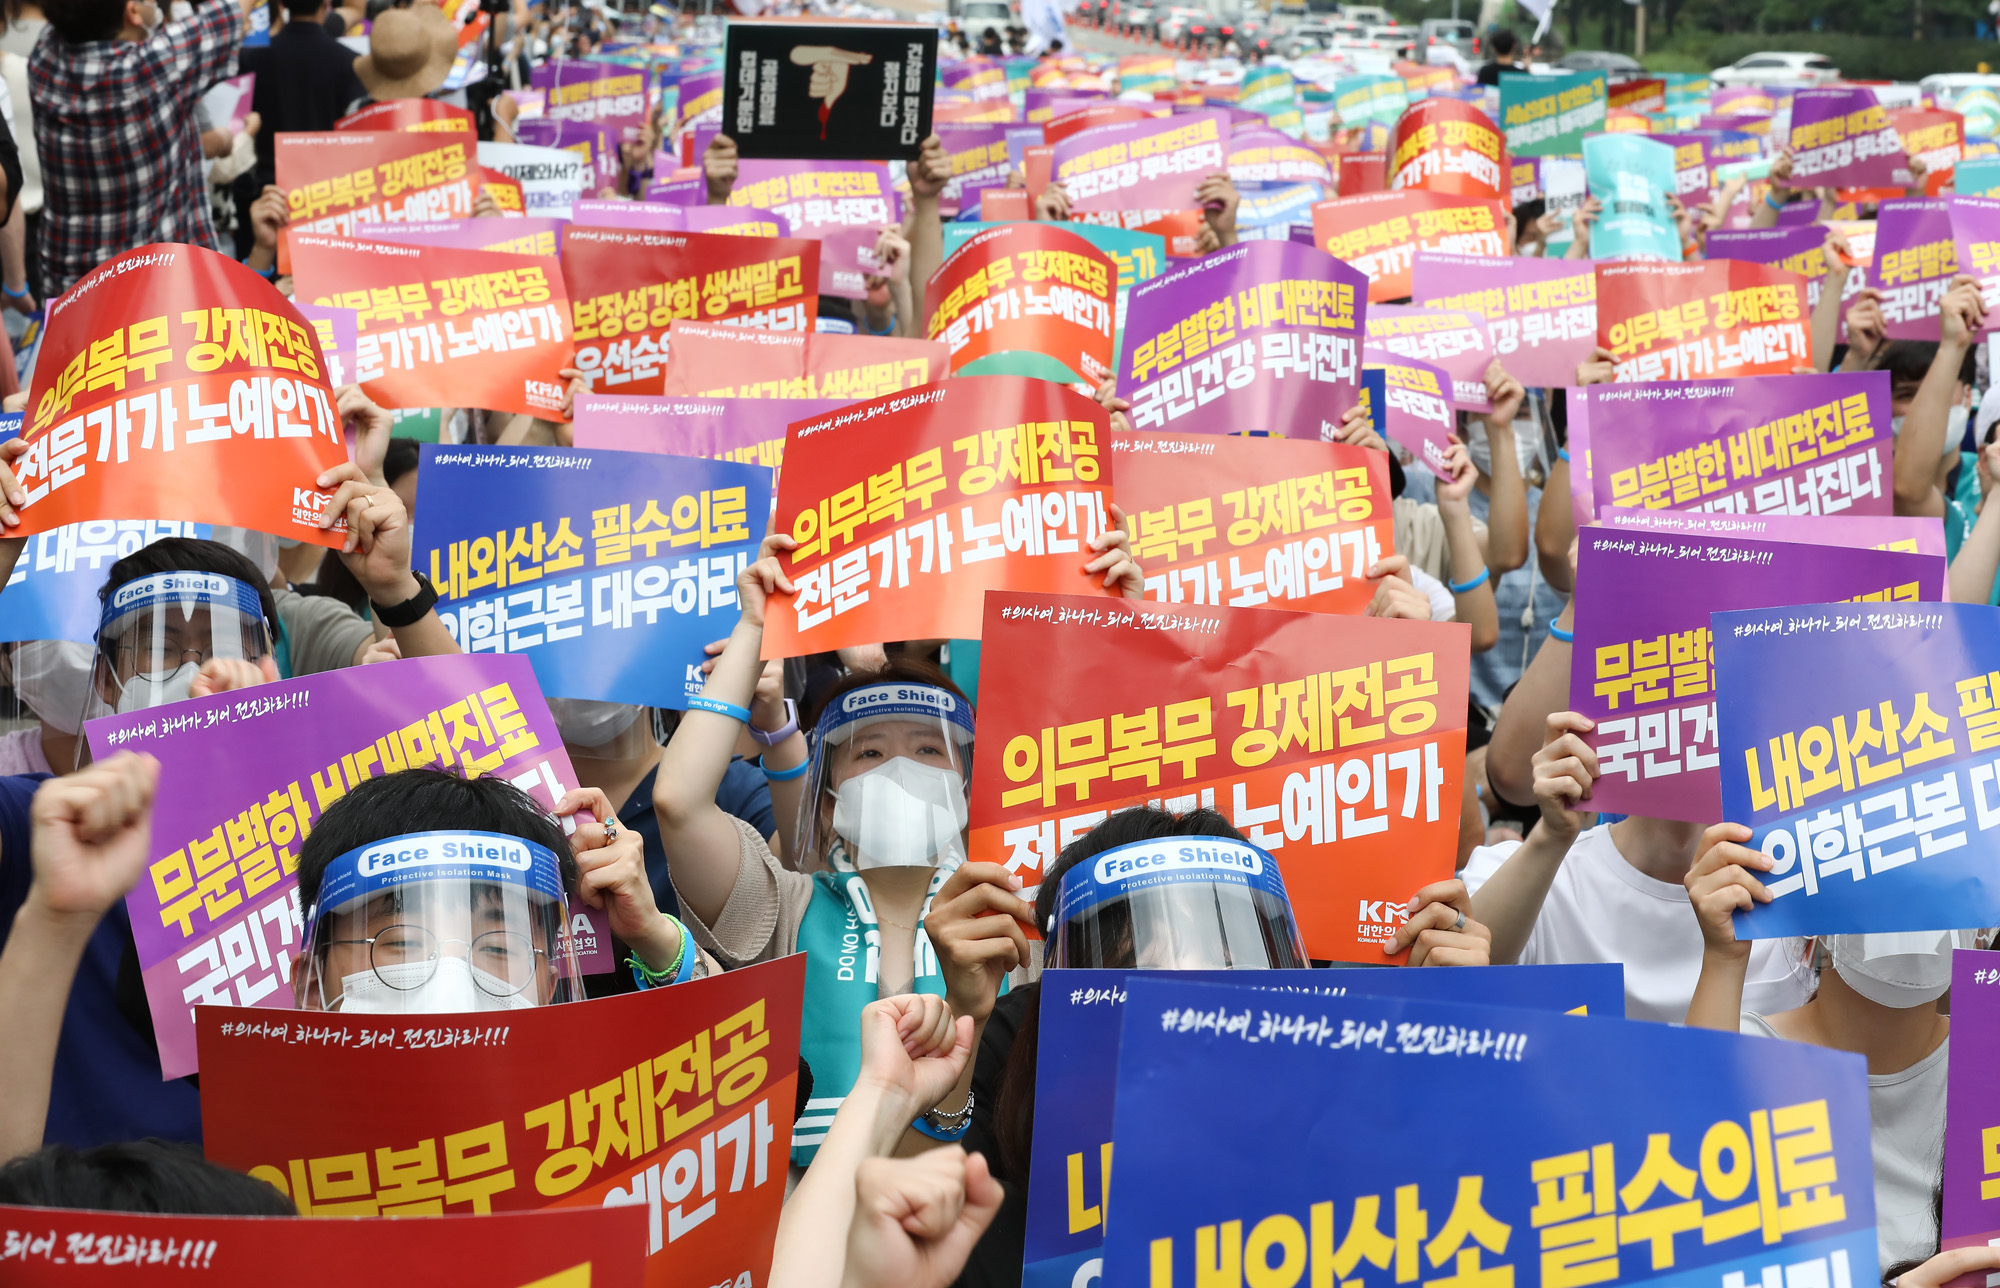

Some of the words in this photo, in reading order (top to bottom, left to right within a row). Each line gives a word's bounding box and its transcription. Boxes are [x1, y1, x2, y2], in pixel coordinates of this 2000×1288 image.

[288, 167, 377, 220] 의무복무
[378, 142, 466, 198] 강제전공
[1412, 206, 1496, 238] 강제전공
[431, 266, 551, 317] 강제전공
[574, 277, 700, 341] 보장성강화
[701, 255, 803, 317] 생색말고
[1018, 250, 1109, 298] 강제전공
[1024, 284, 1112, 338] 노예인가
[356, 322, 444, 384] 문가가
[444, 304, 564, 359] 노예인가
[1131, 295, 1236, 384] 무분별한
[1238, 278, 1355, 330] 비대면진료
[1609, 298, 1708, 356] 의무복무
[1710, 284, 1800, 330] 강제전공
[1717, 322, 1807, 370] 노예인가
[25, 315, 172, 441] 의무복무
[181, 306, 320, 380] 강제전공
[1132, 338, 1256, 429] 국민건강
[1261, 332, 1357, 386] 무너진다
[15, 387, 178, 511] 전문가가
[186, 376, 340, 445] 노예인가
[797, 389, 946, 438] #의사여_하나가_되어_전진하라!!!
[1610, 439, 1727, 509] 무분별한
[1728, 391, 1875, 481] 비대면진료
[435, 453, 592, 470] #의사여_하나가_되어_전진하라!!!
[791, 446, 947, 565] 의무복무
[953, 420, 1100, 495] 강제전공
[430, 516, 584, 601] 내외산소
[591, 486, 749, 566] 필수의료
[1221, 466, 1373, 547] 강제전공
[1614, 515, 1766, 532] #의사여_하나가_되어_전진하라!!!
[792, 512, 953, 632] 전문가가
[961, 490, 1108, 566] 노예인가
[1228, 525, 1382, 608] 노예인가
[1593, 539, 1774, 565] #의사여_하나가_되어_전진하라!!!
[118, 584, 154, 603] Face
[162, 579, 220, 590] Shield
[1001, 605, 1220, 635] #의사여_하나가_되어_전진하라!!!
[1734, 613, 1943, 638] #의사여_하나가_되어_전진하라!!!
[848, 692, 889, 708] Face
[897, 689, 949, 707] Shield
[1594, 627, 1714, 711] 무분별
[107, 690, 310, 745] #의사여_하나가_되어_전진하라!!!
[857, 707, 892, 717] Protective
[1001, 696, 1217, 809] 의무복무
[1226, 652, 1439, 768] 강제전공
[1597, 701, 1719, 782] 국민건
[1745, 692, 1956, 812] 내외산소
[1233, 742, 1444, 851] 노예인가
[149, 780, 312, 938] 무분별한
[368, 847, 429, 870] Face
[442, 842, 521, 865] Shield
[1104, 853, 1166, 878] Face
[1178, 847, 1254, 869] Shield
[1760, 771, 1969, 900] 의학근본
[381, 871, 434, 885] Protective
[437, 868, 484, 876] Isolation
[487, 870, 512, 880] Mask
[1120, 873, 1173, 891] Protective
[1176, 872, 1221, 881] Isolation
[1223, 873, 1247, 884] Mask
[1359, 900, 1410, 924] KM
[221, 1022, 510, 1049] #의사여_하나가_되어_전진하라!!!
[1161, 1007, 1528, 1061] #의사여_하나가_되어_전진하라!!!
[525, 998, 770, 1197] 강제전공
[602, 1097, 775, 1258] 예인가
[1530, 1098, 1847, 1274] 필수의료
